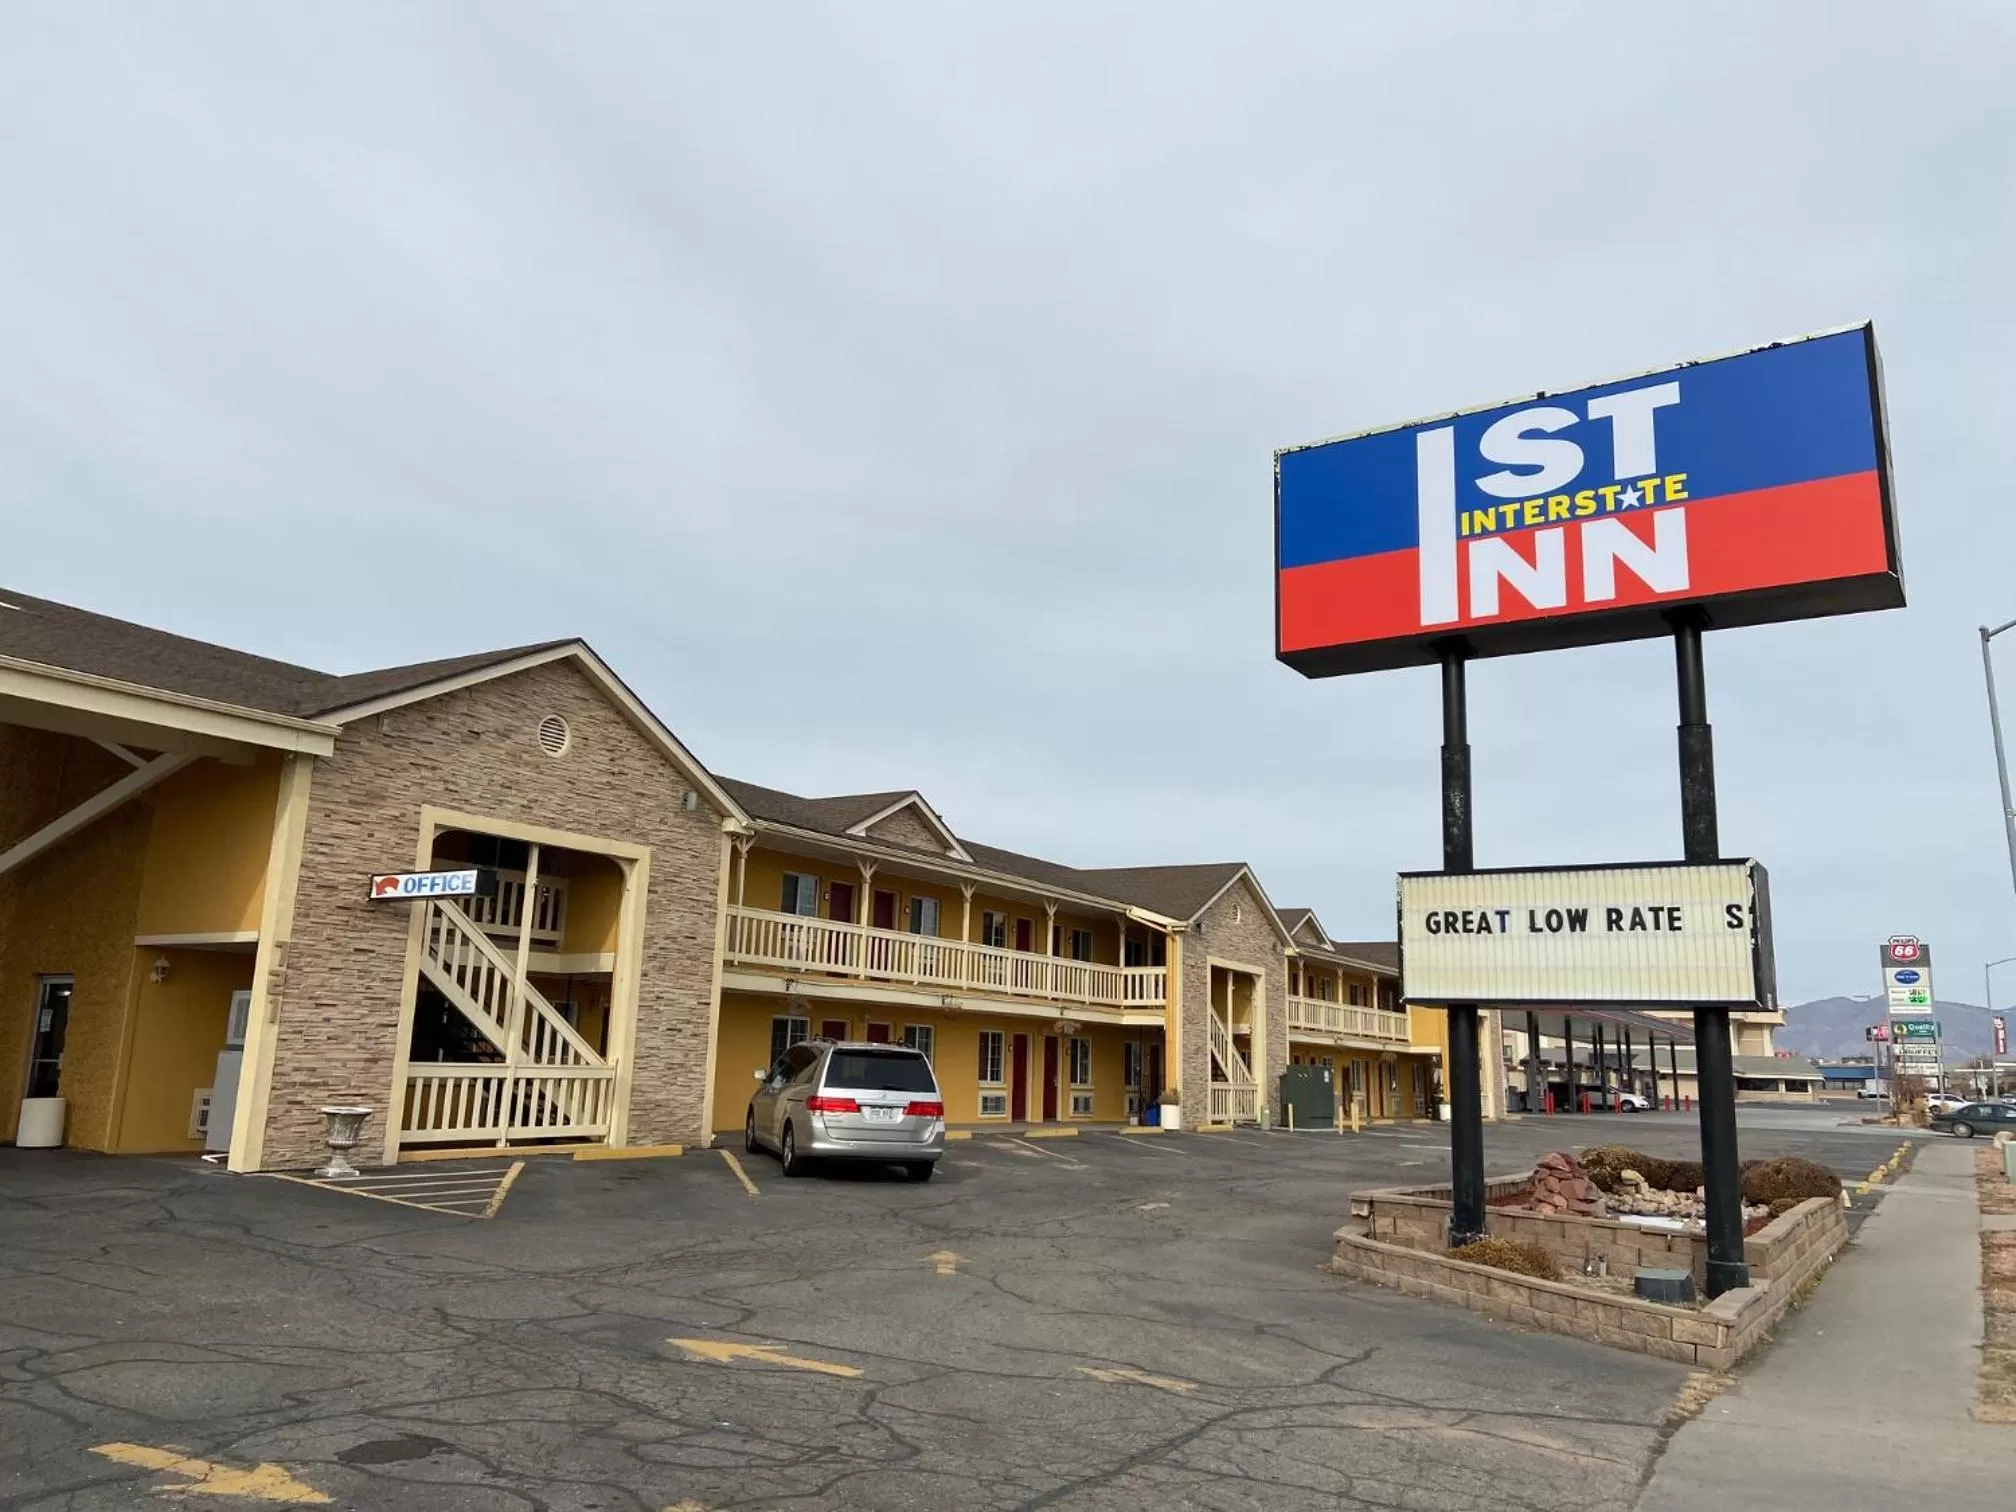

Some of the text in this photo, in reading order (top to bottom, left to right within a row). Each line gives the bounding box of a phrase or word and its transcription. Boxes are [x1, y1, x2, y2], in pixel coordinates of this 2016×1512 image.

[404, 873, 474, 894] OFFICE
[1425, 903, 1744, 935] GREAT LOW RATE S
[1894, 945, 1914, 956] 66
